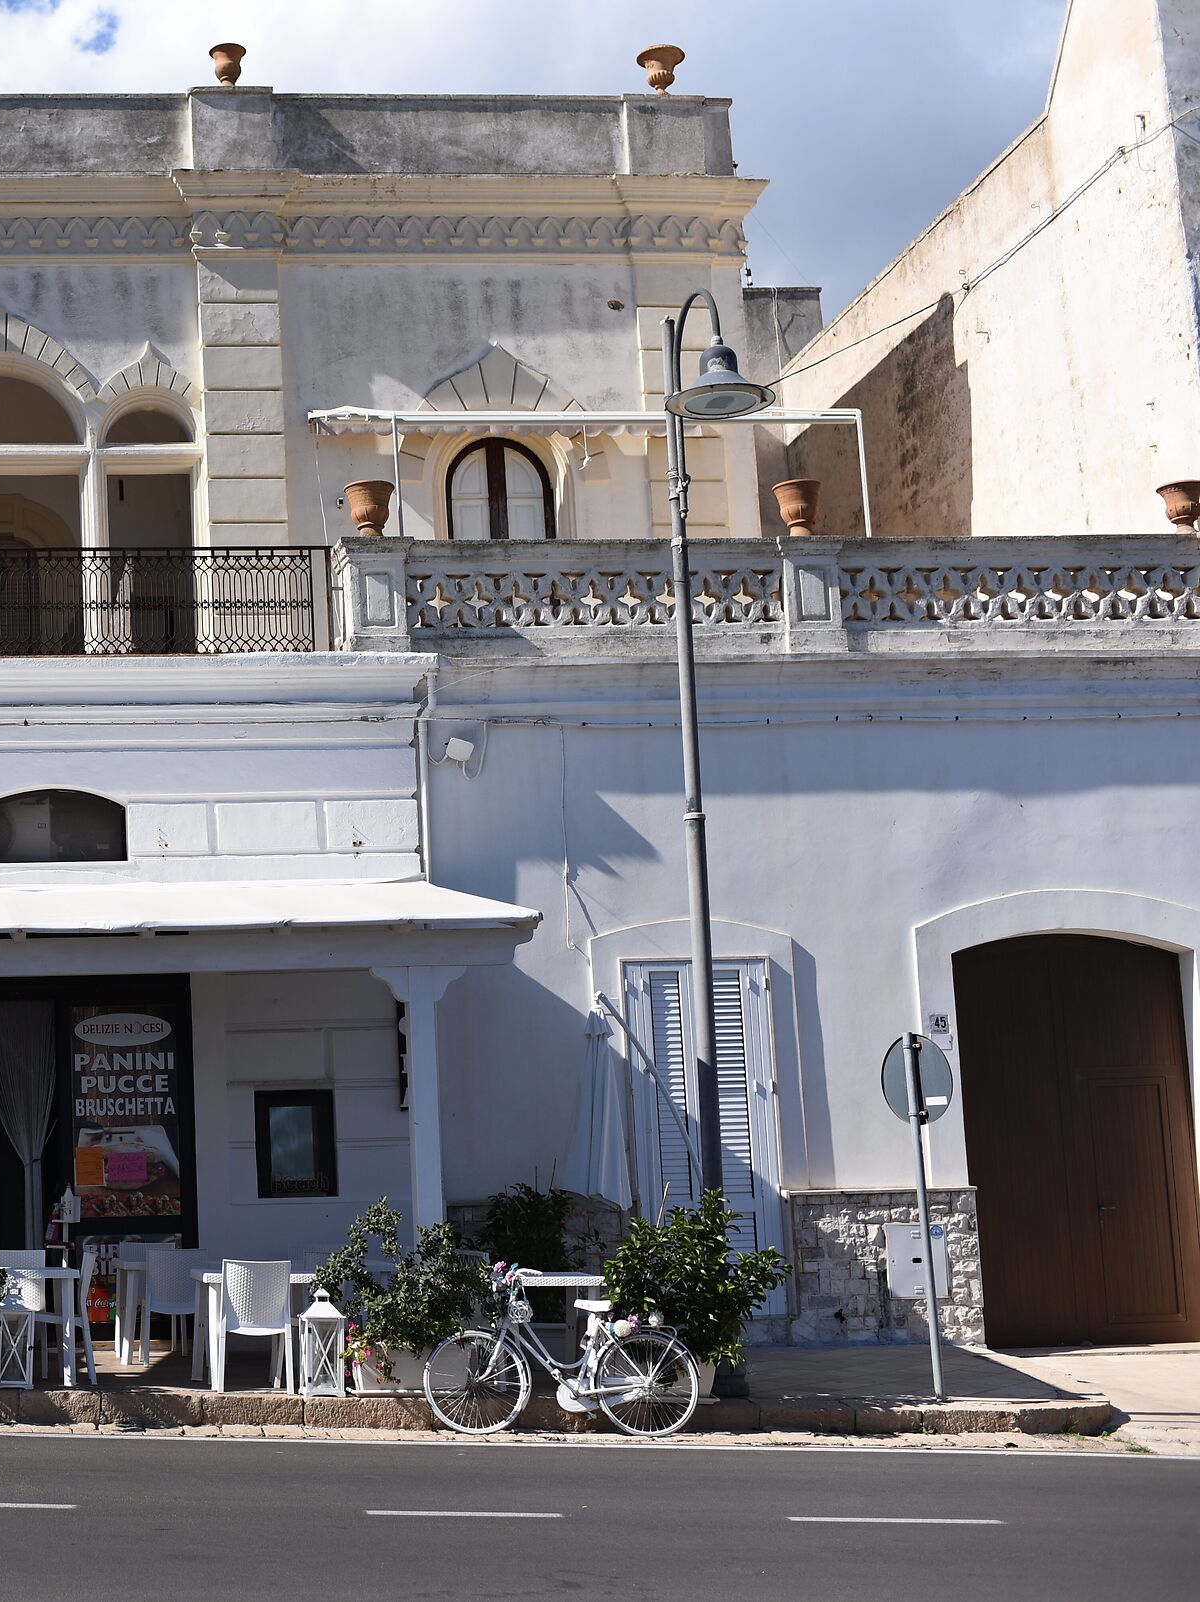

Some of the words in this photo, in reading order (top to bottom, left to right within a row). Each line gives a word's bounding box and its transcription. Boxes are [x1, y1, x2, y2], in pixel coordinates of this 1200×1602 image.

[83, 1024, 120, 1034] DELIZIE
[934, 1016, 947, 1028] 45
[74, 1052, 174, 1071] PANINI
[81, 1074, 169, 1093] PUCCE
[75, 1097, 176, 1117] BRUSCHETTA
